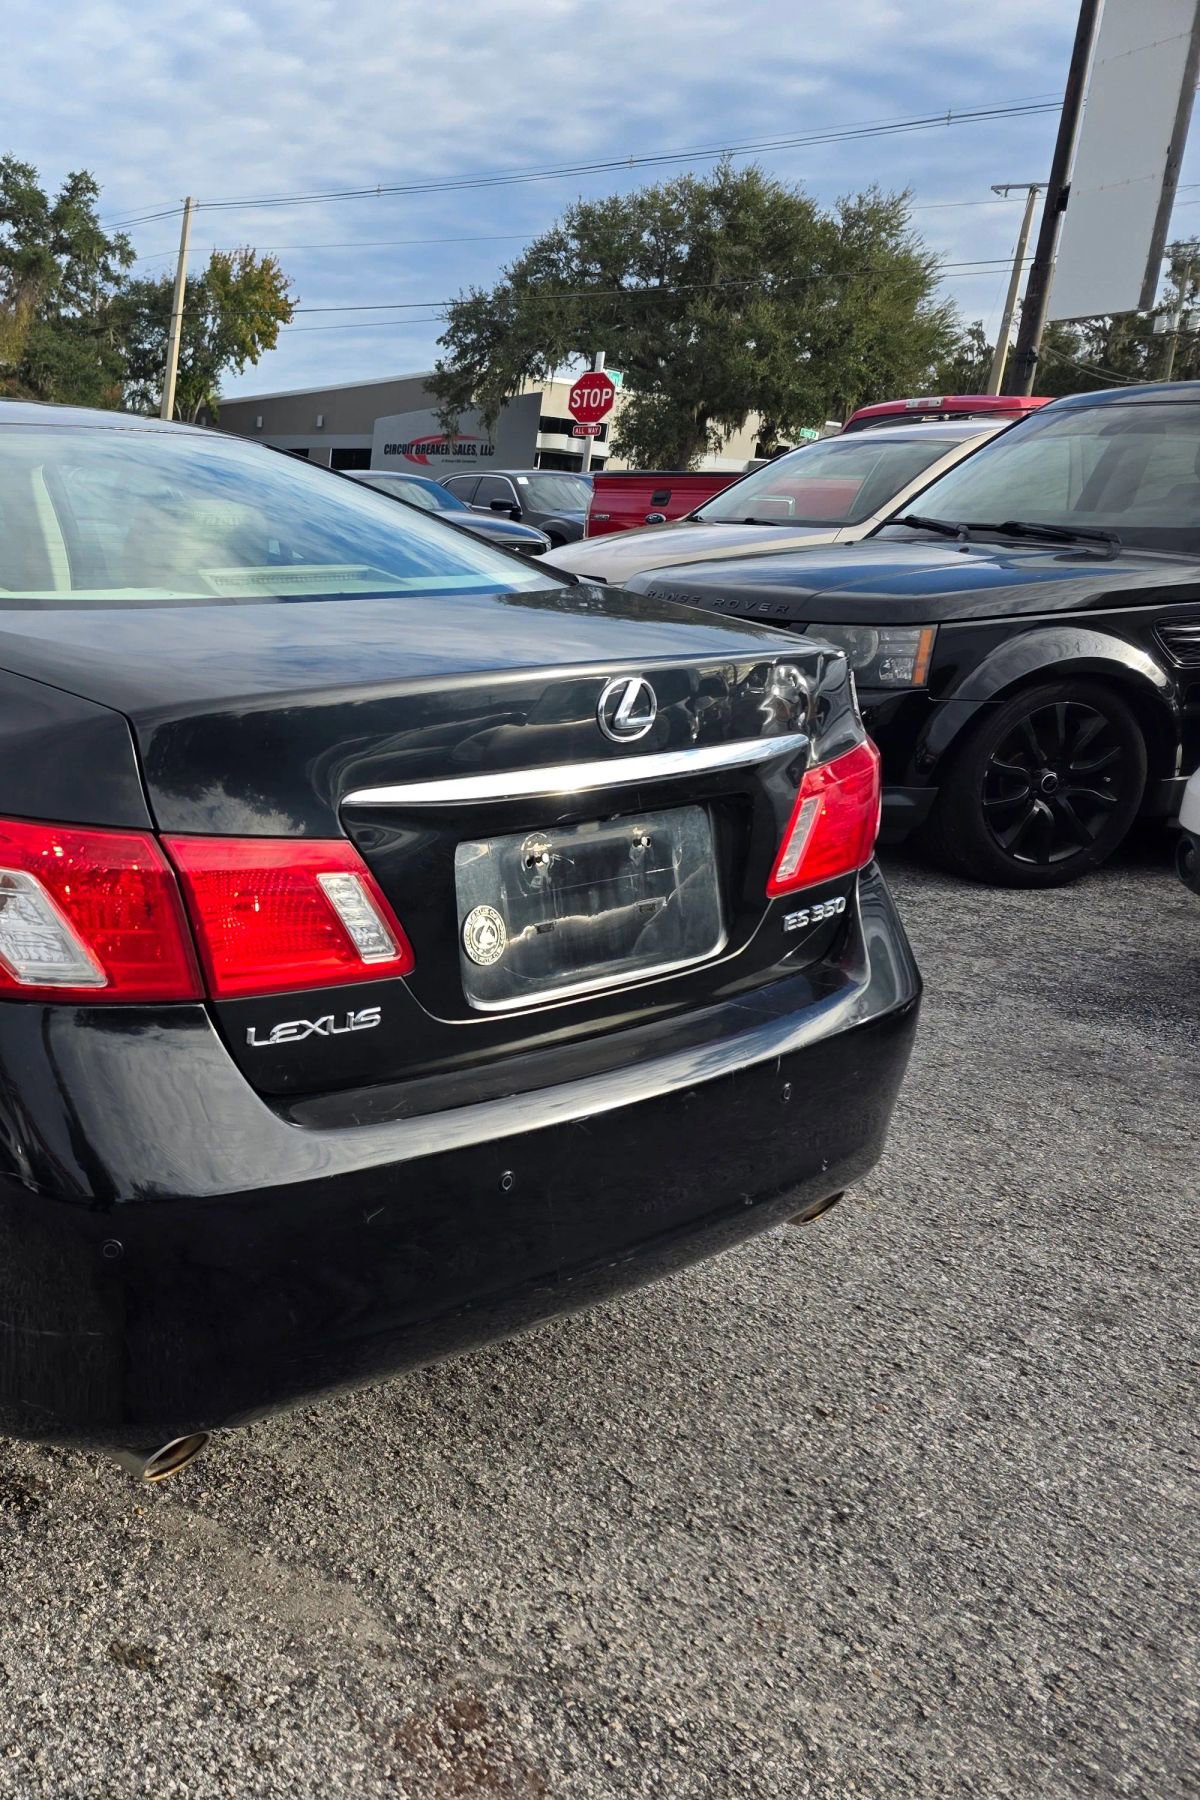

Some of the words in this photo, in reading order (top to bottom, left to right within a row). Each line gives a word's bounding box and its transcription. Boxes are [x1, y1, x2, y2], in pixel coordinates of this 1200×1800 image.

[571, 388, 612, 408] STOP
[588, 427, 599, 435] WAY
[383, 443, 415, 455] CIRCUIT
[415, 444, 451, 456] BREAKER
[452, 444, 478, 457] SALES,
[480, 444, 495, 457] LLC
[647, 590, 701, 604] RANGE
[712, 598, 790, 614] ROVER
[782, 909, 810, 932] ES
[810, 896, 846, 922] 350
[246, 1006, 381, 1046] LEXUS
